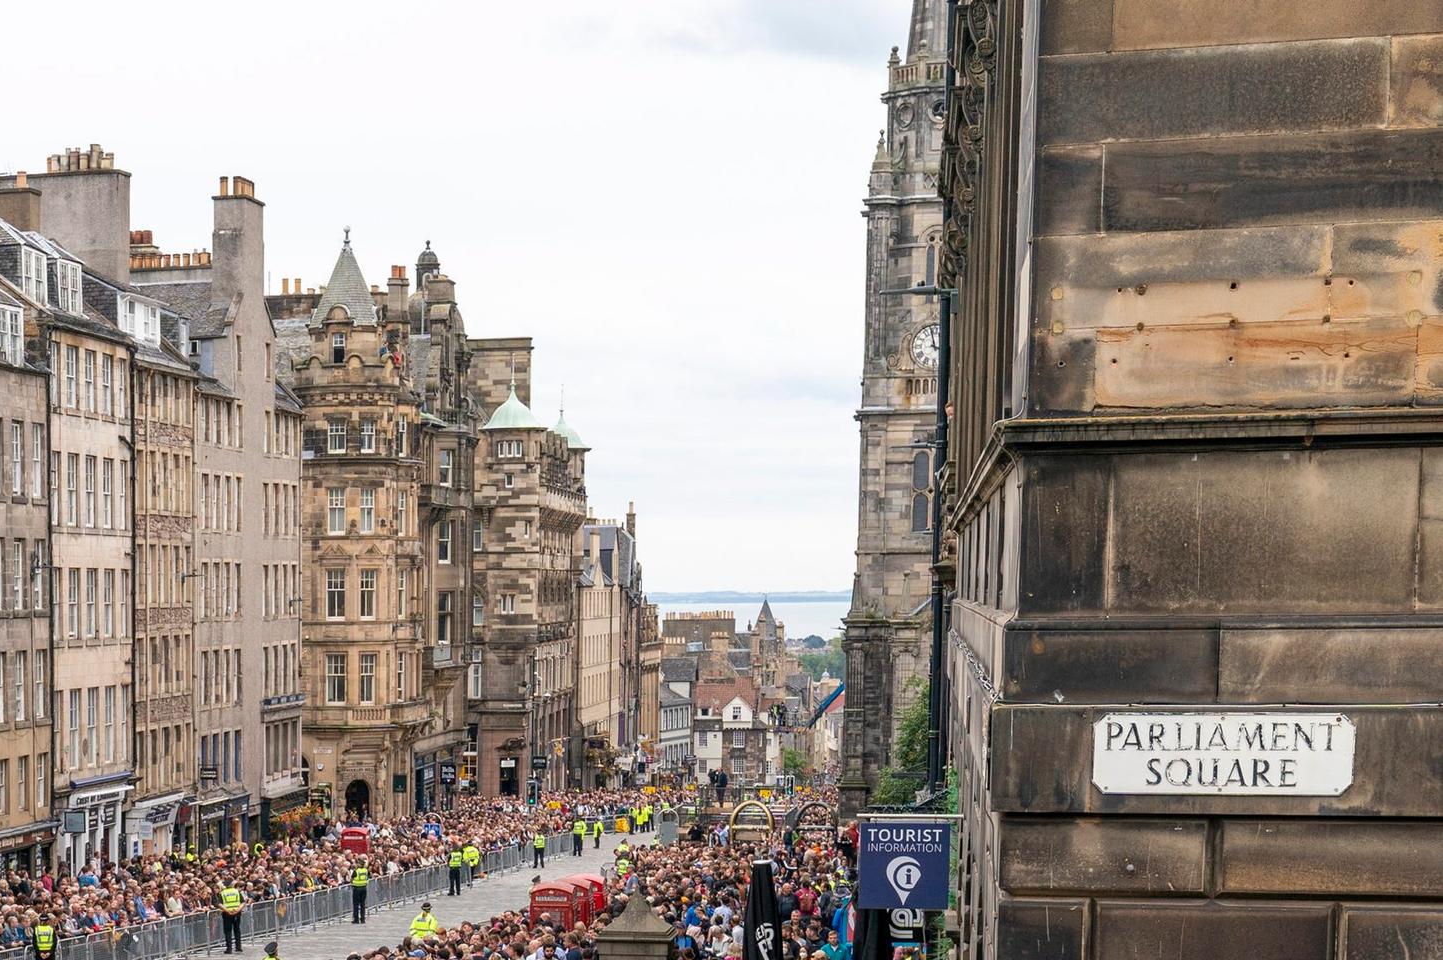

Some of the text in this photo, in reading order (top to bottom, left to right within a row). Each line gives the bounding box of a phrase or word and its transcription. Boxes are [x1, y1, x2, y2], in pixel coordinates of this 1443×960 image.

[1105, 722, 1341, 751] PARLIAMENT
[1145, 758, 1298, 787] SQUARE
[867, 828, 943, 842] TOURIST
[867, 842, 942, 853] INFORMATION
